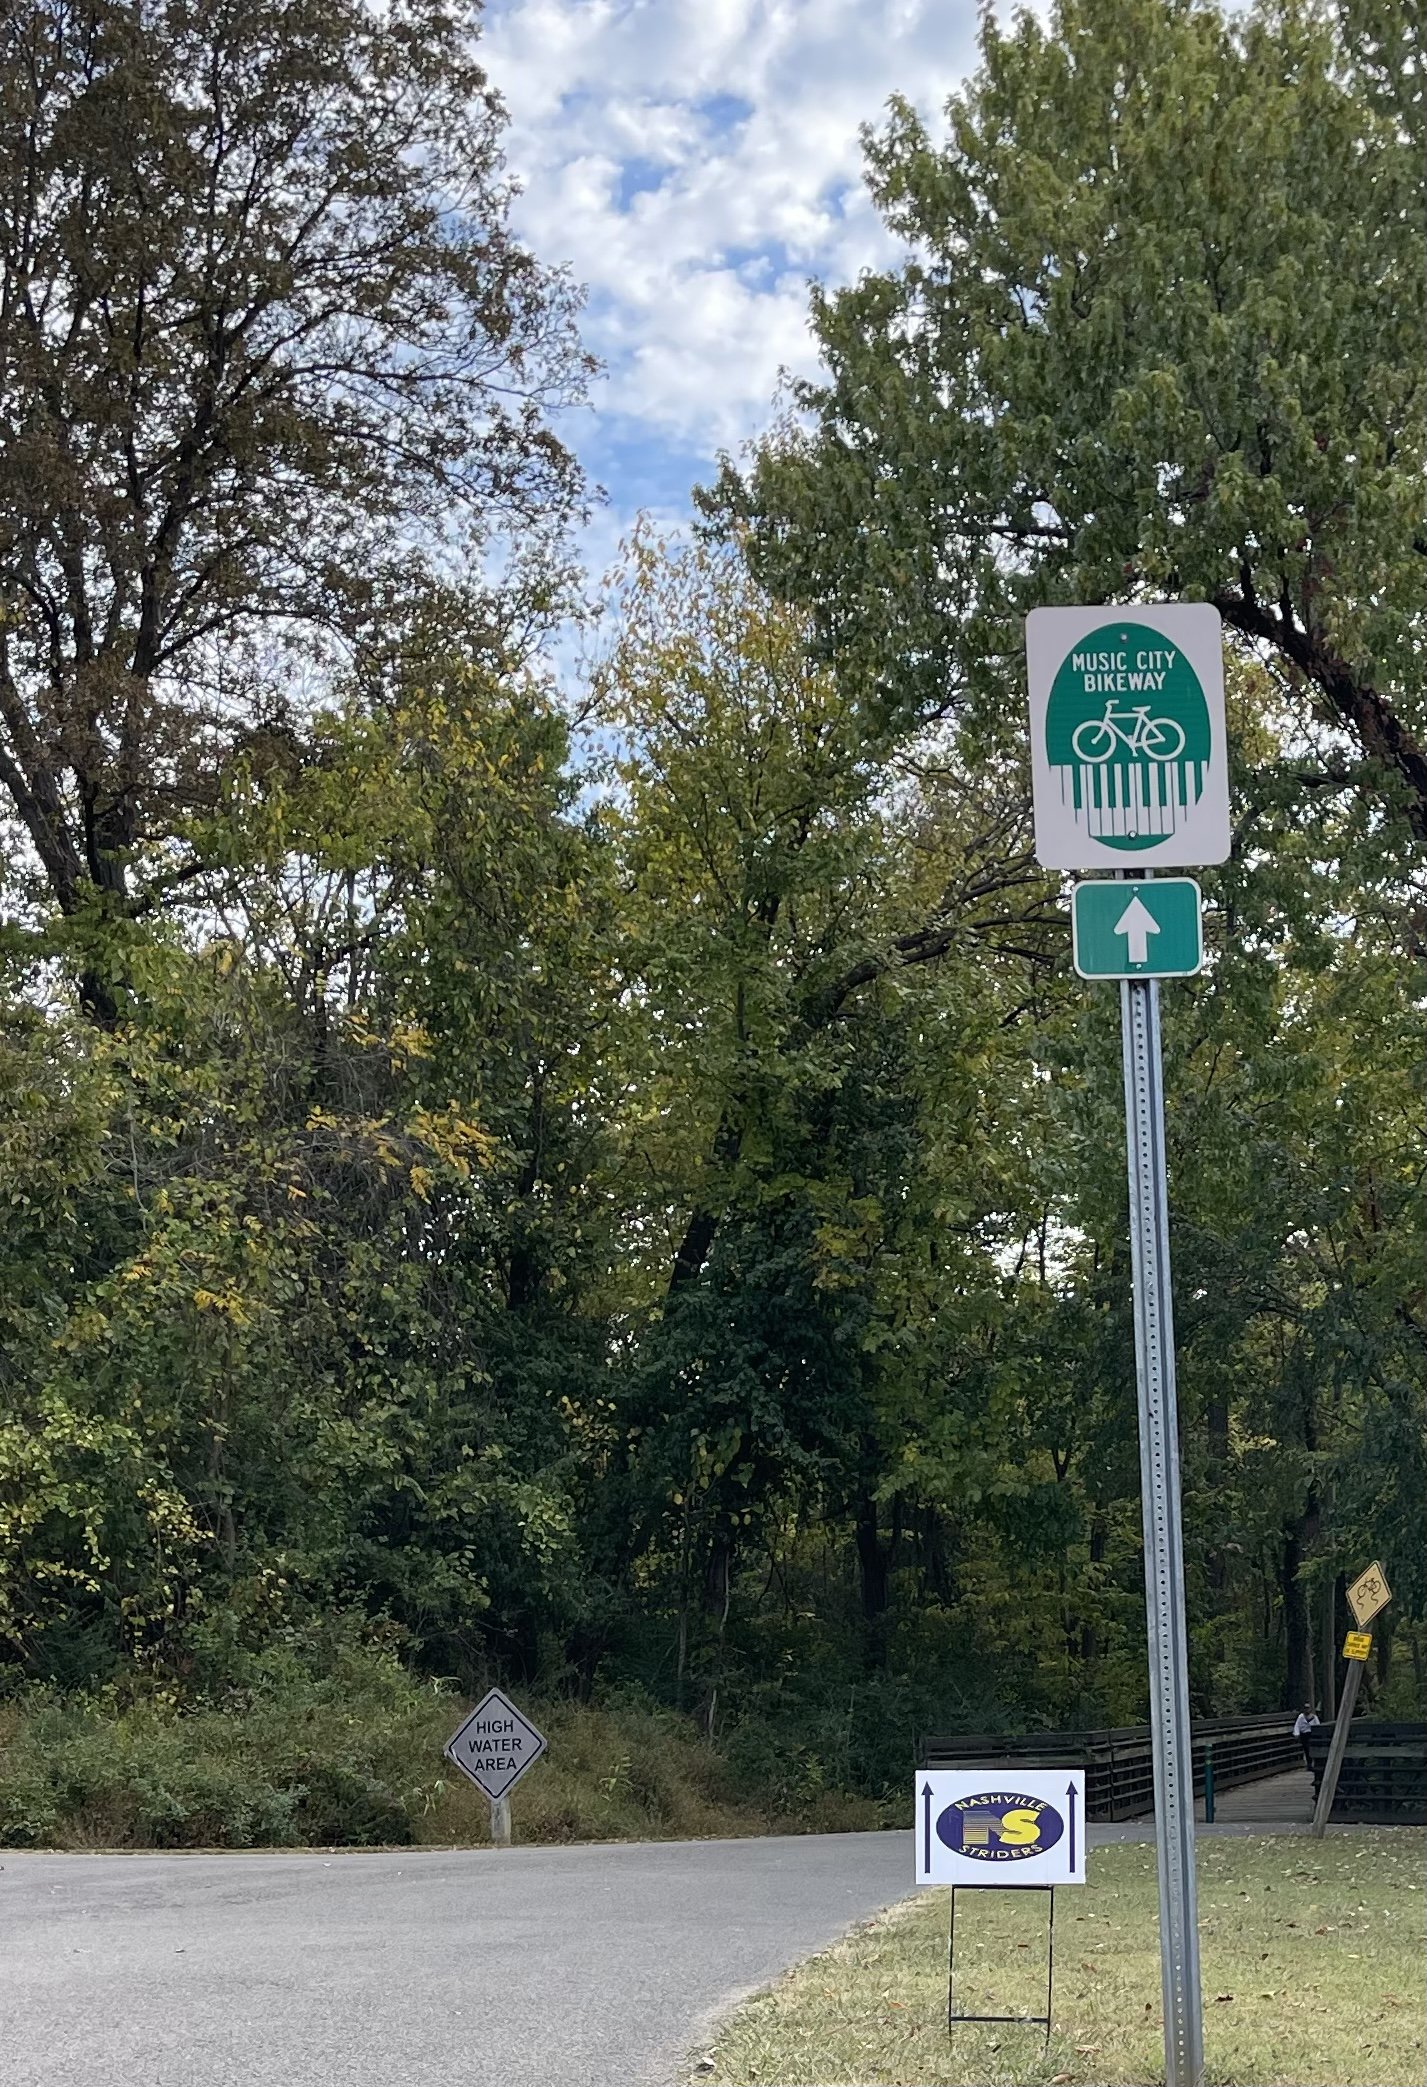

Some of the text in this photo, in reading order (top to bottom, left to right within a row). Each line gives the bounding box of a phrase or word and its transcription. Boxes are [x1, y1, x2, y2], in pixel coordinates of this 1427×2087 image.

[1072, 650, 1176, 672] MUSIC CITY
[1084, 671, 1166, 692] BIKEWAY
[476, 1720, 514, 1734] HIGH
[468, 1738, 522, 1753] WATER
[474, 1757, 517, 1772] AREA
[954, 1795, 1048, 1812] NASHVILLE
[959, 1844, 1043, 1859] STRIDERS
